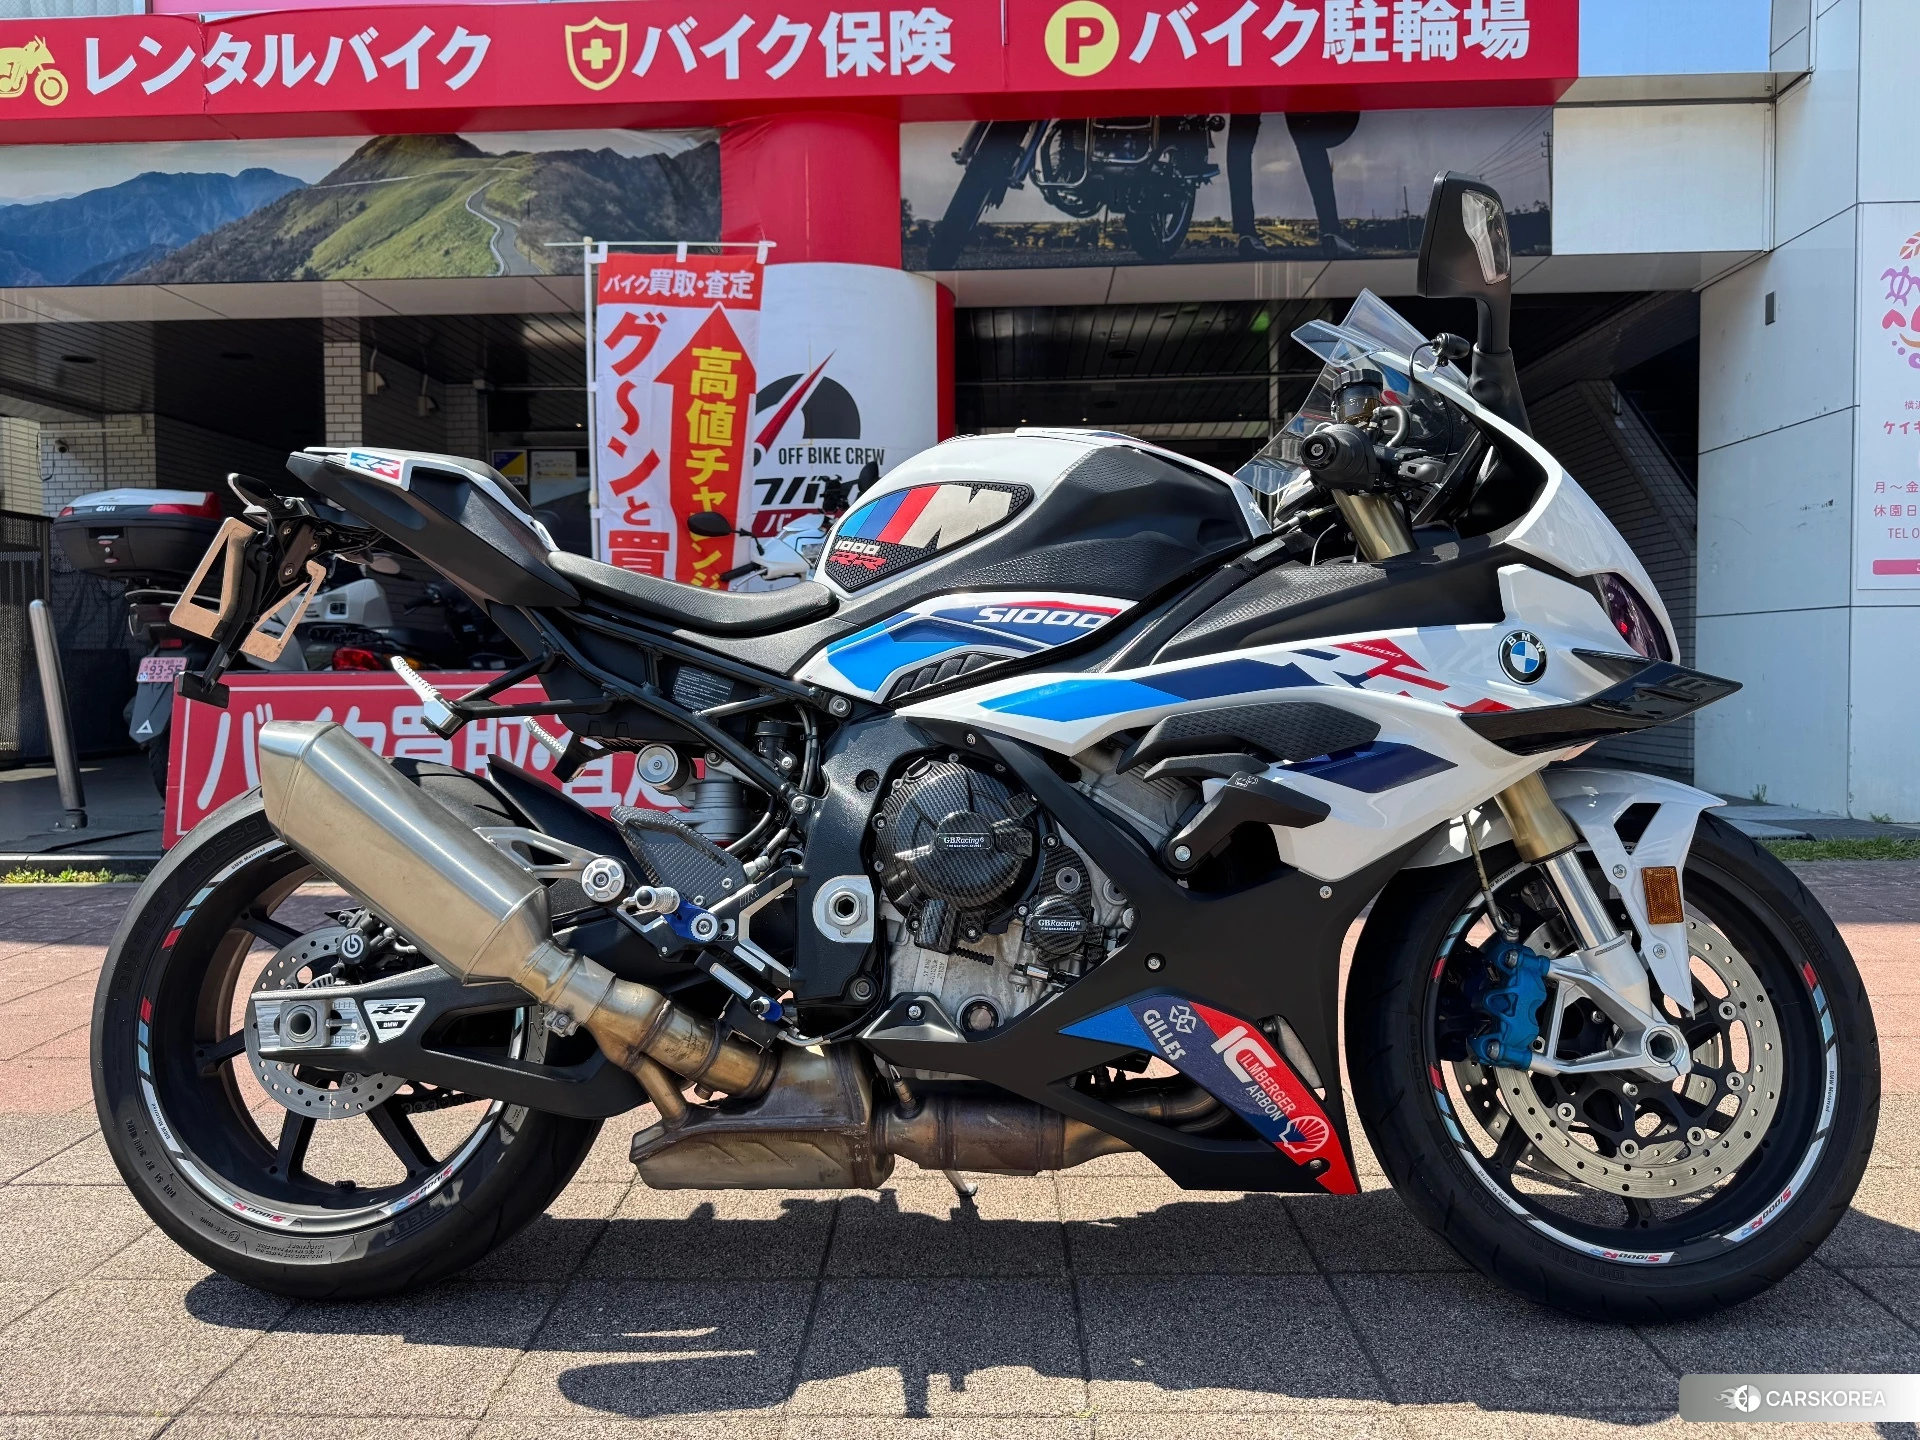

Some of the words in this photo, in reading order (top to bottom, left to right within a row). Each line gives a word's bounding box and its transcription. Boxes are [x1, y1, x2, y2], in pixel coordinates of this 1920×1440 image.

[633, 9, 956, 79] バイク保険
[1064, 16, 1103, 64] P
[1129, 0, 1530, 67] バイク駐輪場
[86, 25, 491, 96] レンタルバイク
[603, 268, 755, 300] バイク買取・査定
[778, 448, 801, 465] OFF
[808, 447, 841, 464] BIKE
[846, 447, 885, 465] CREW
[1873, 504, 1917, 517] 休園日
[1888, 528, 1908, 539] TEL
[835, 540, 881, 554] 1000
[973, 607, 1112, 629] S1000
[1507, 632, 1546, 653] BMW
[187, 819, 261, 874] ROSSO
[231, 857, 245, 870] BMW
[244, 847, 266, 863] Motorrad
[1494, 868, 1517, 885] Motorrad
[1143, 1009, 1187, 1061] GILLES
[1239, 1053, 1297, 1115] ILMBERGER
[1440, 1143, 1499, 1218] ROSSO
[1478, 1169, 1498, 1192] Motorrad
[1498, 1190, 1511, 1204] BMW
